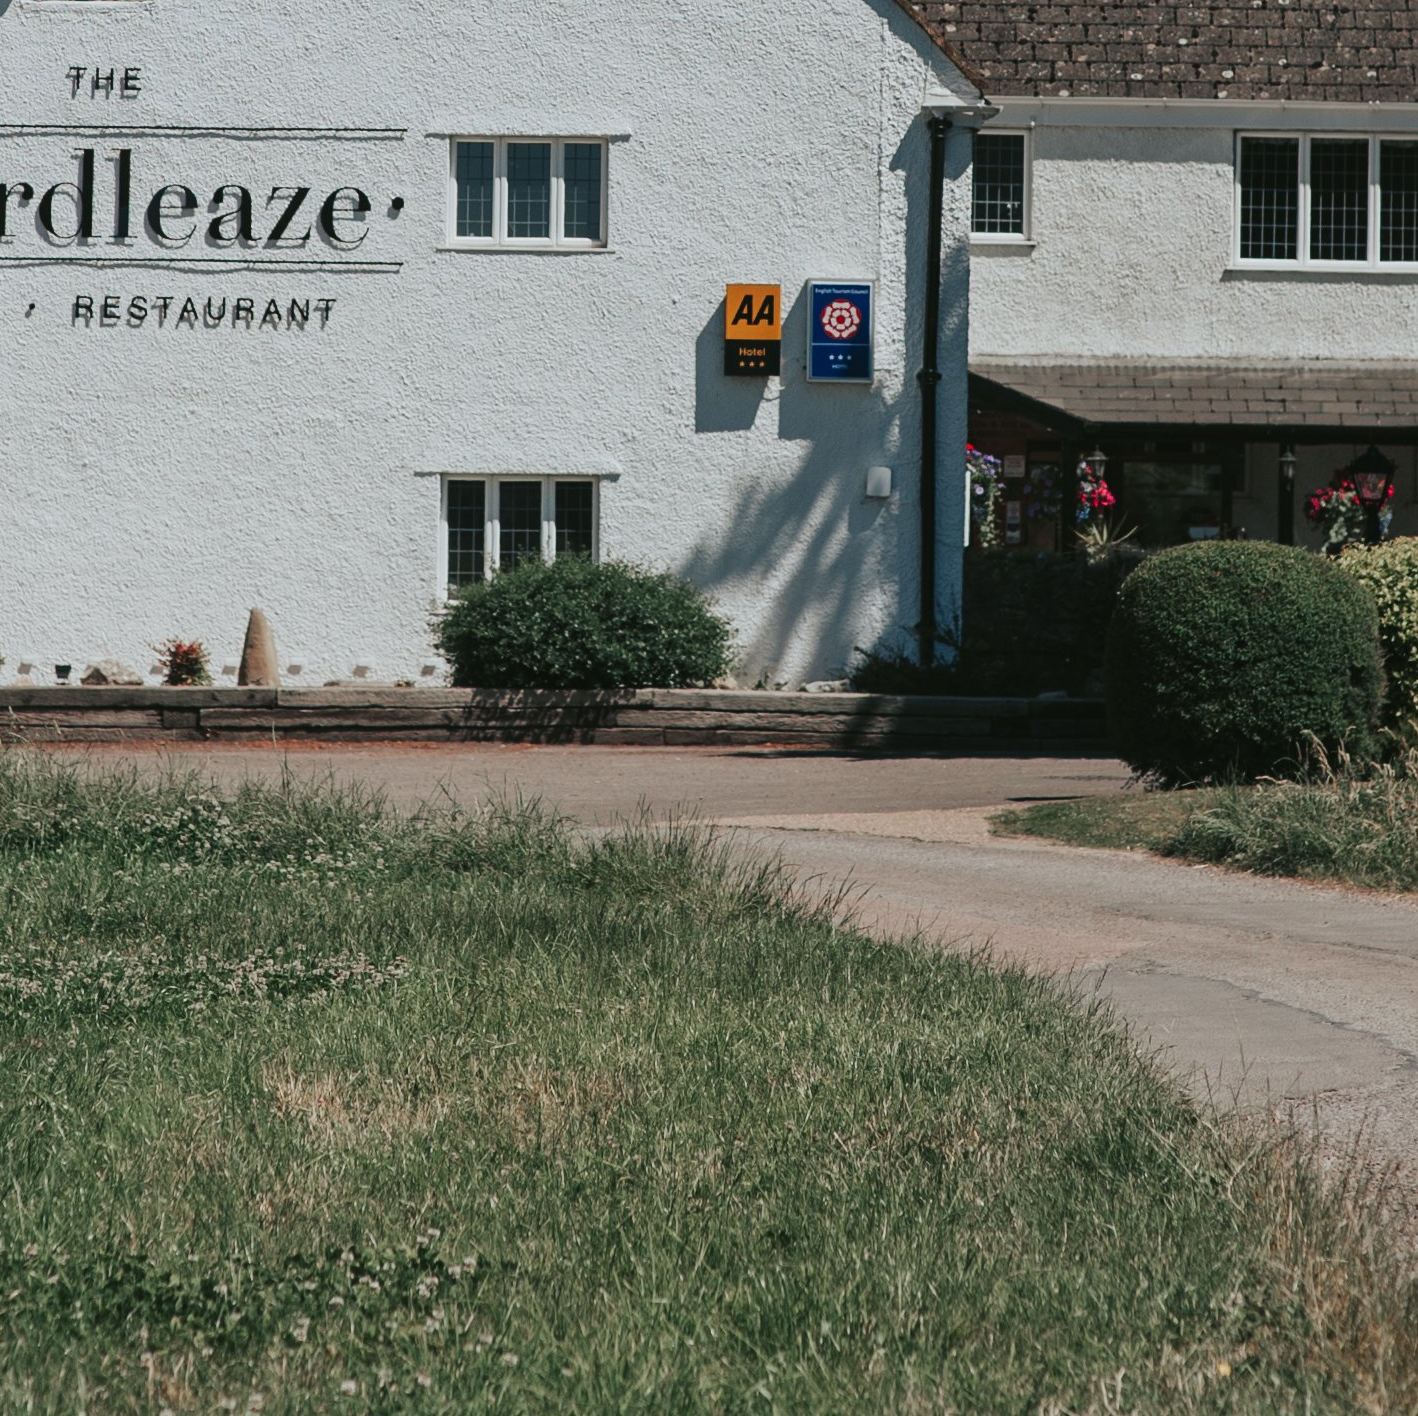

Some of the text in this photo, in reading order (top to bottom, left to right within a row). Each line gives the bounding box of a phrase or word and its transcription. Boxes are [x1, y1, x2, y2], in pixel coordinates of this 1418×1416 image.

[68, 65, 143, 93] THE
[74, 295, 337, 324] RESTAURANT
[731, 294, 775, 326] AA
[739, 347, 766, 356] Hotel
